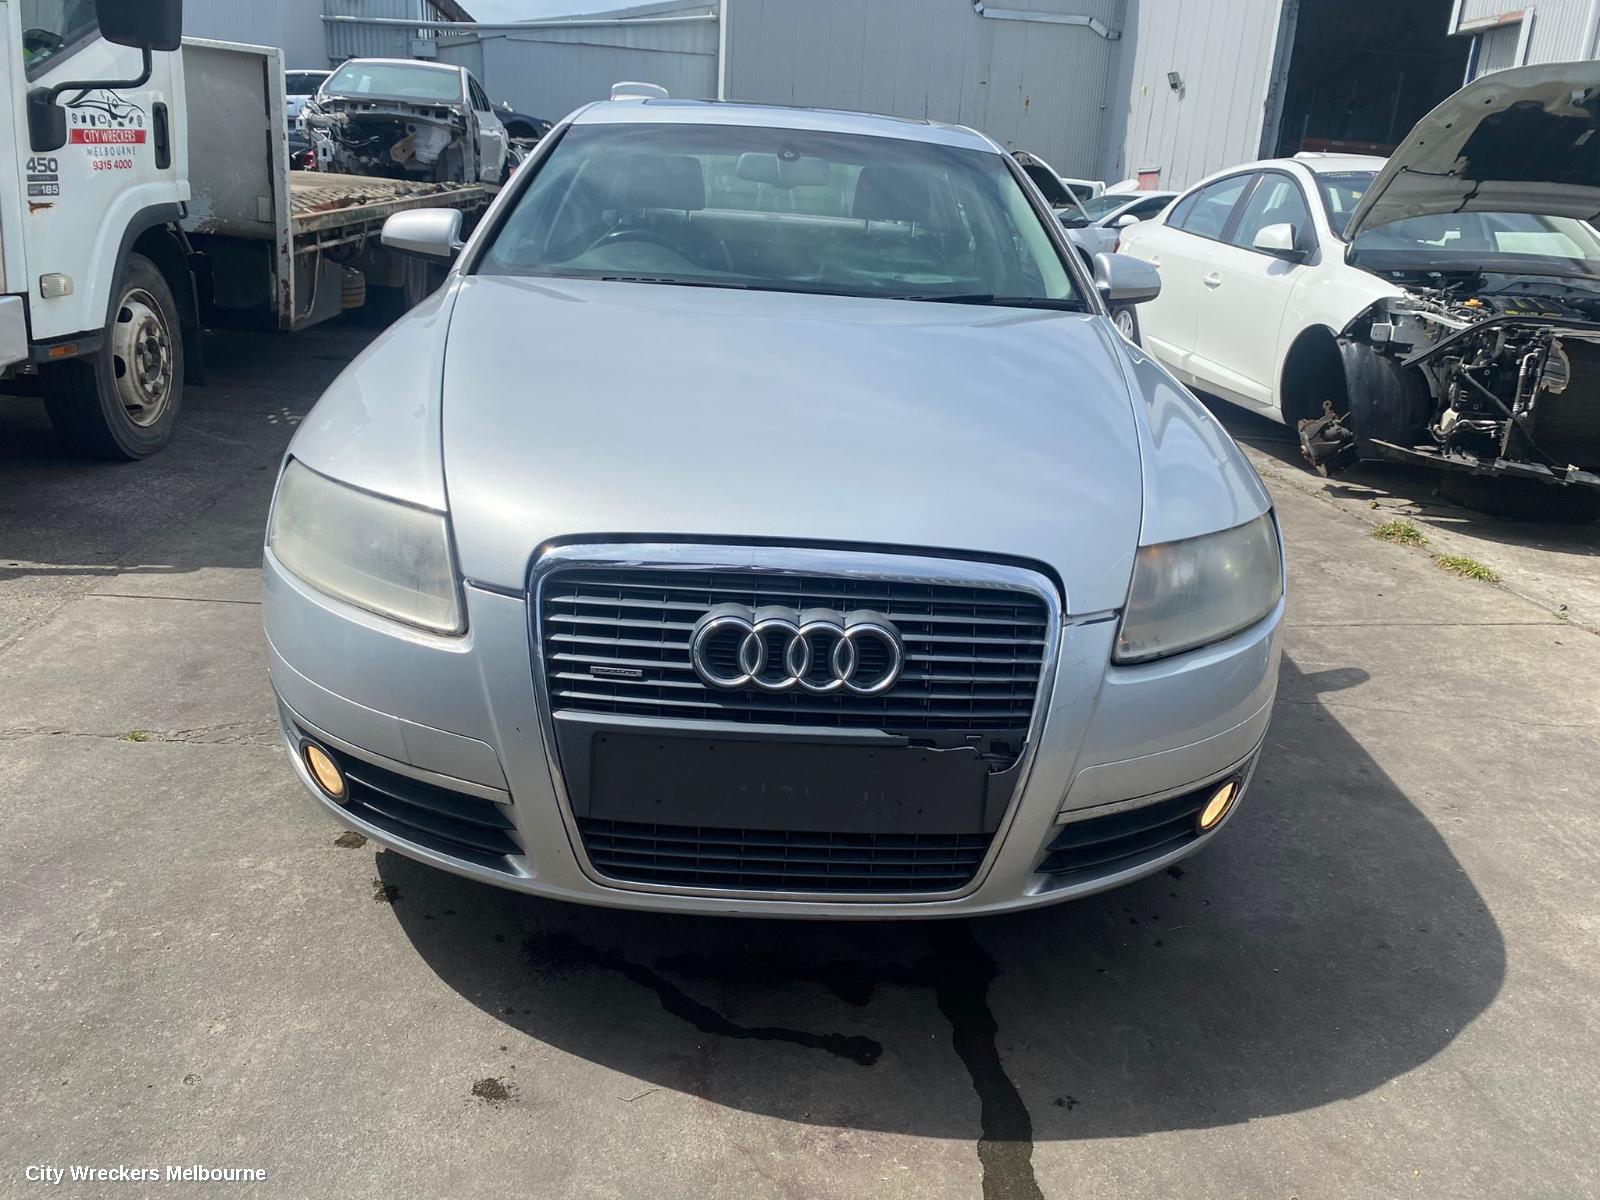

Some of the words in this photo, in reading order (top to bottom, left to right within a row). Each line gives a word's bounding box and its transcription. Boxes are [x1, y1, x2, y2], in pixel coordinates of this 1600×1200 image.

[83, 129, 99, 143] CITY
[100, 129, 136, 143] WRECKERS
[86, 146, 136, 156] MELBOURNE
[26, 157, 58, 173] 450
[93, 160, 112, 170] 9315
[114, 160, 133, 169] 4000
[41, 184, 59, 194] 185
